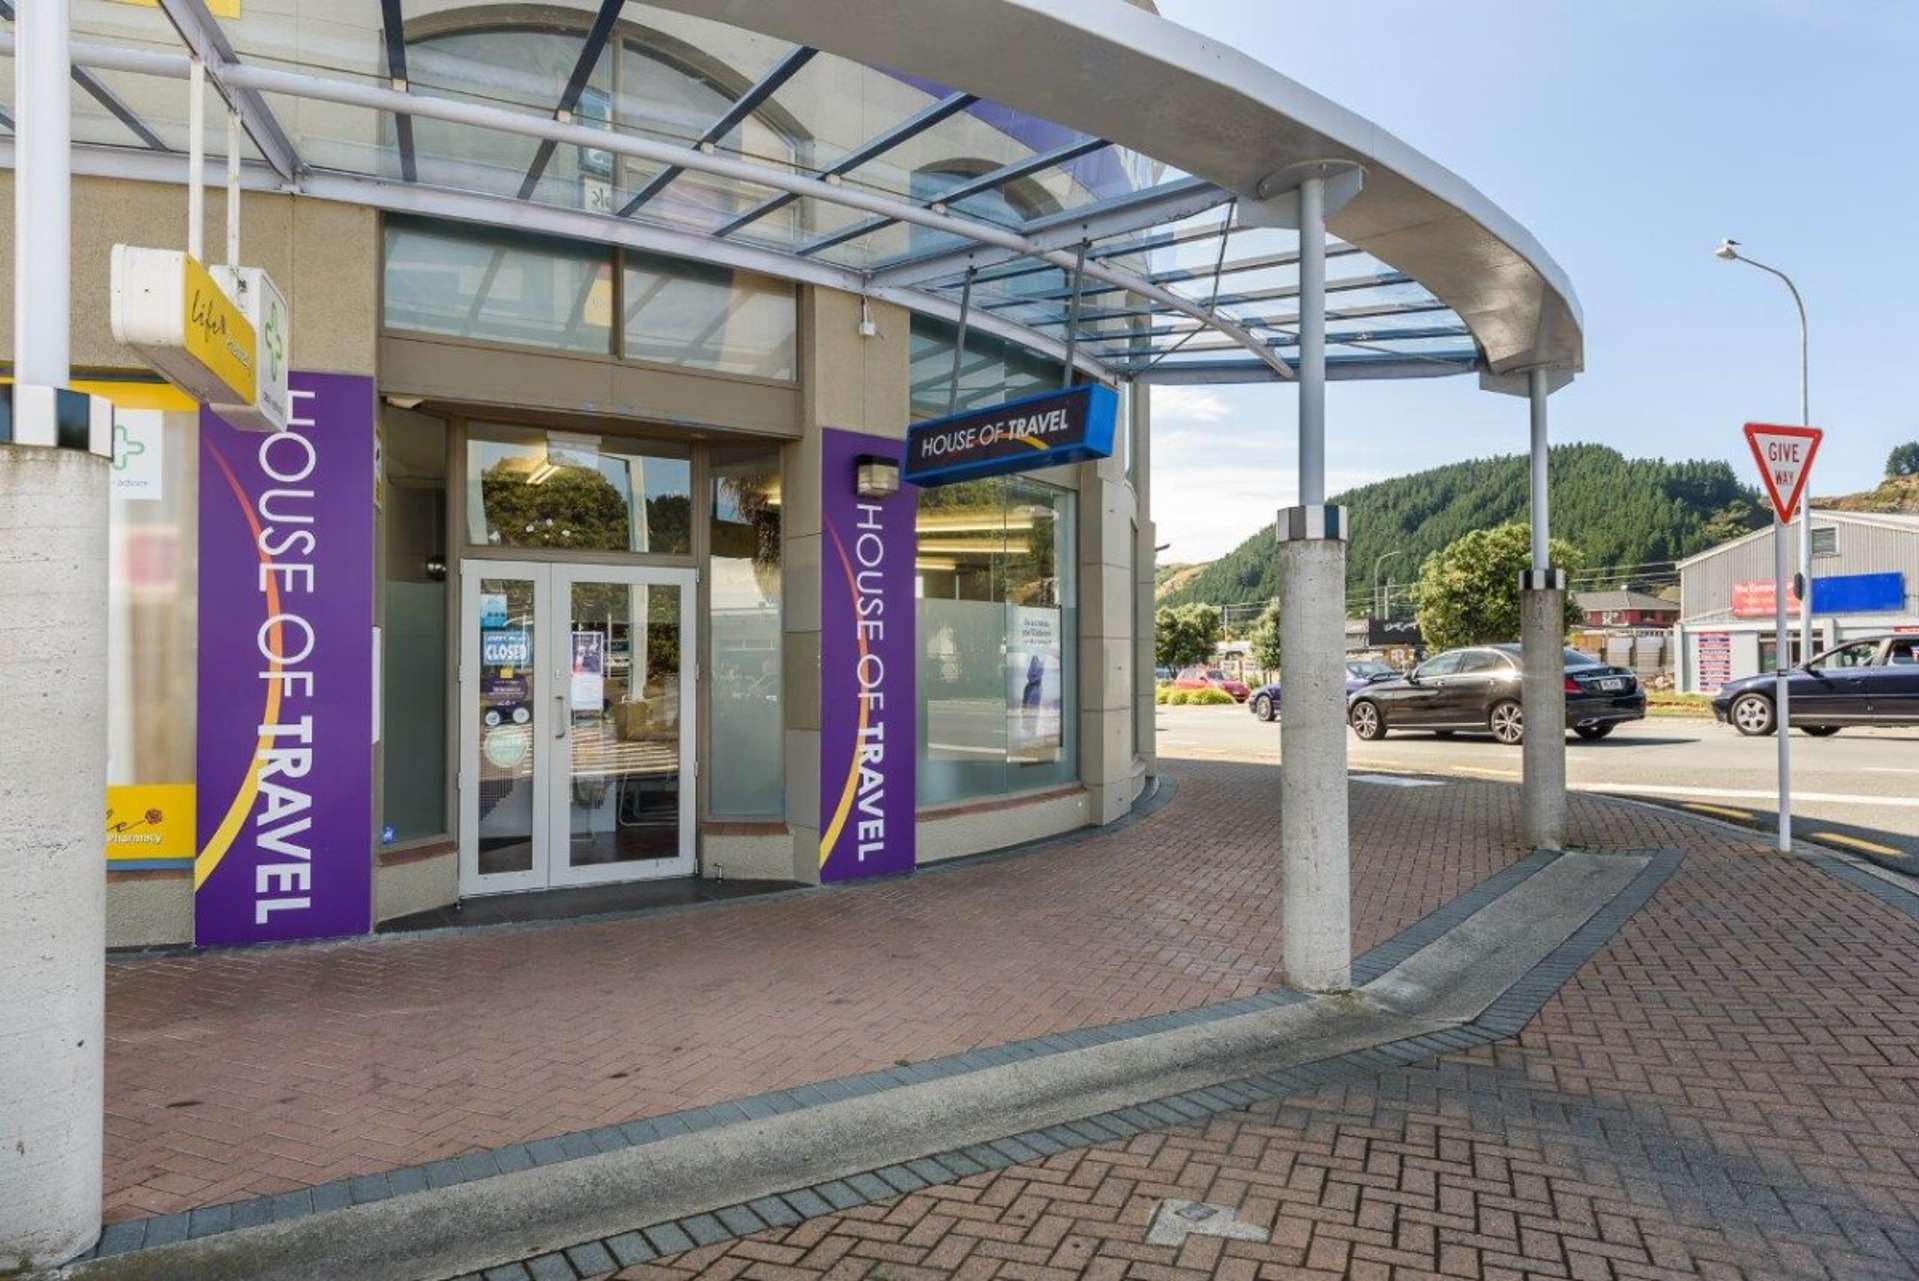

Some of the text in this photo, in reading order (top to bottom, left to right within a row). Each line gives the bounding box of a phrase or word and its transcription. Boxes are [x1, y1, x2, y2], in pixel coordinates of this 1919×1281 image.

[921, 408, 1069, 458] HOUSE OF TRAVEL
[1768, 442, 1800, 463] GIVE
[1775, 469, 1795, 486] WAY
[257, 613, 315, 698] OF
[486, 643, 528, 661] CLOSED
[856, 503, 886, 863] HOUSE OF TRAVEL
[255, 714, 314, 925] TRAVEL
